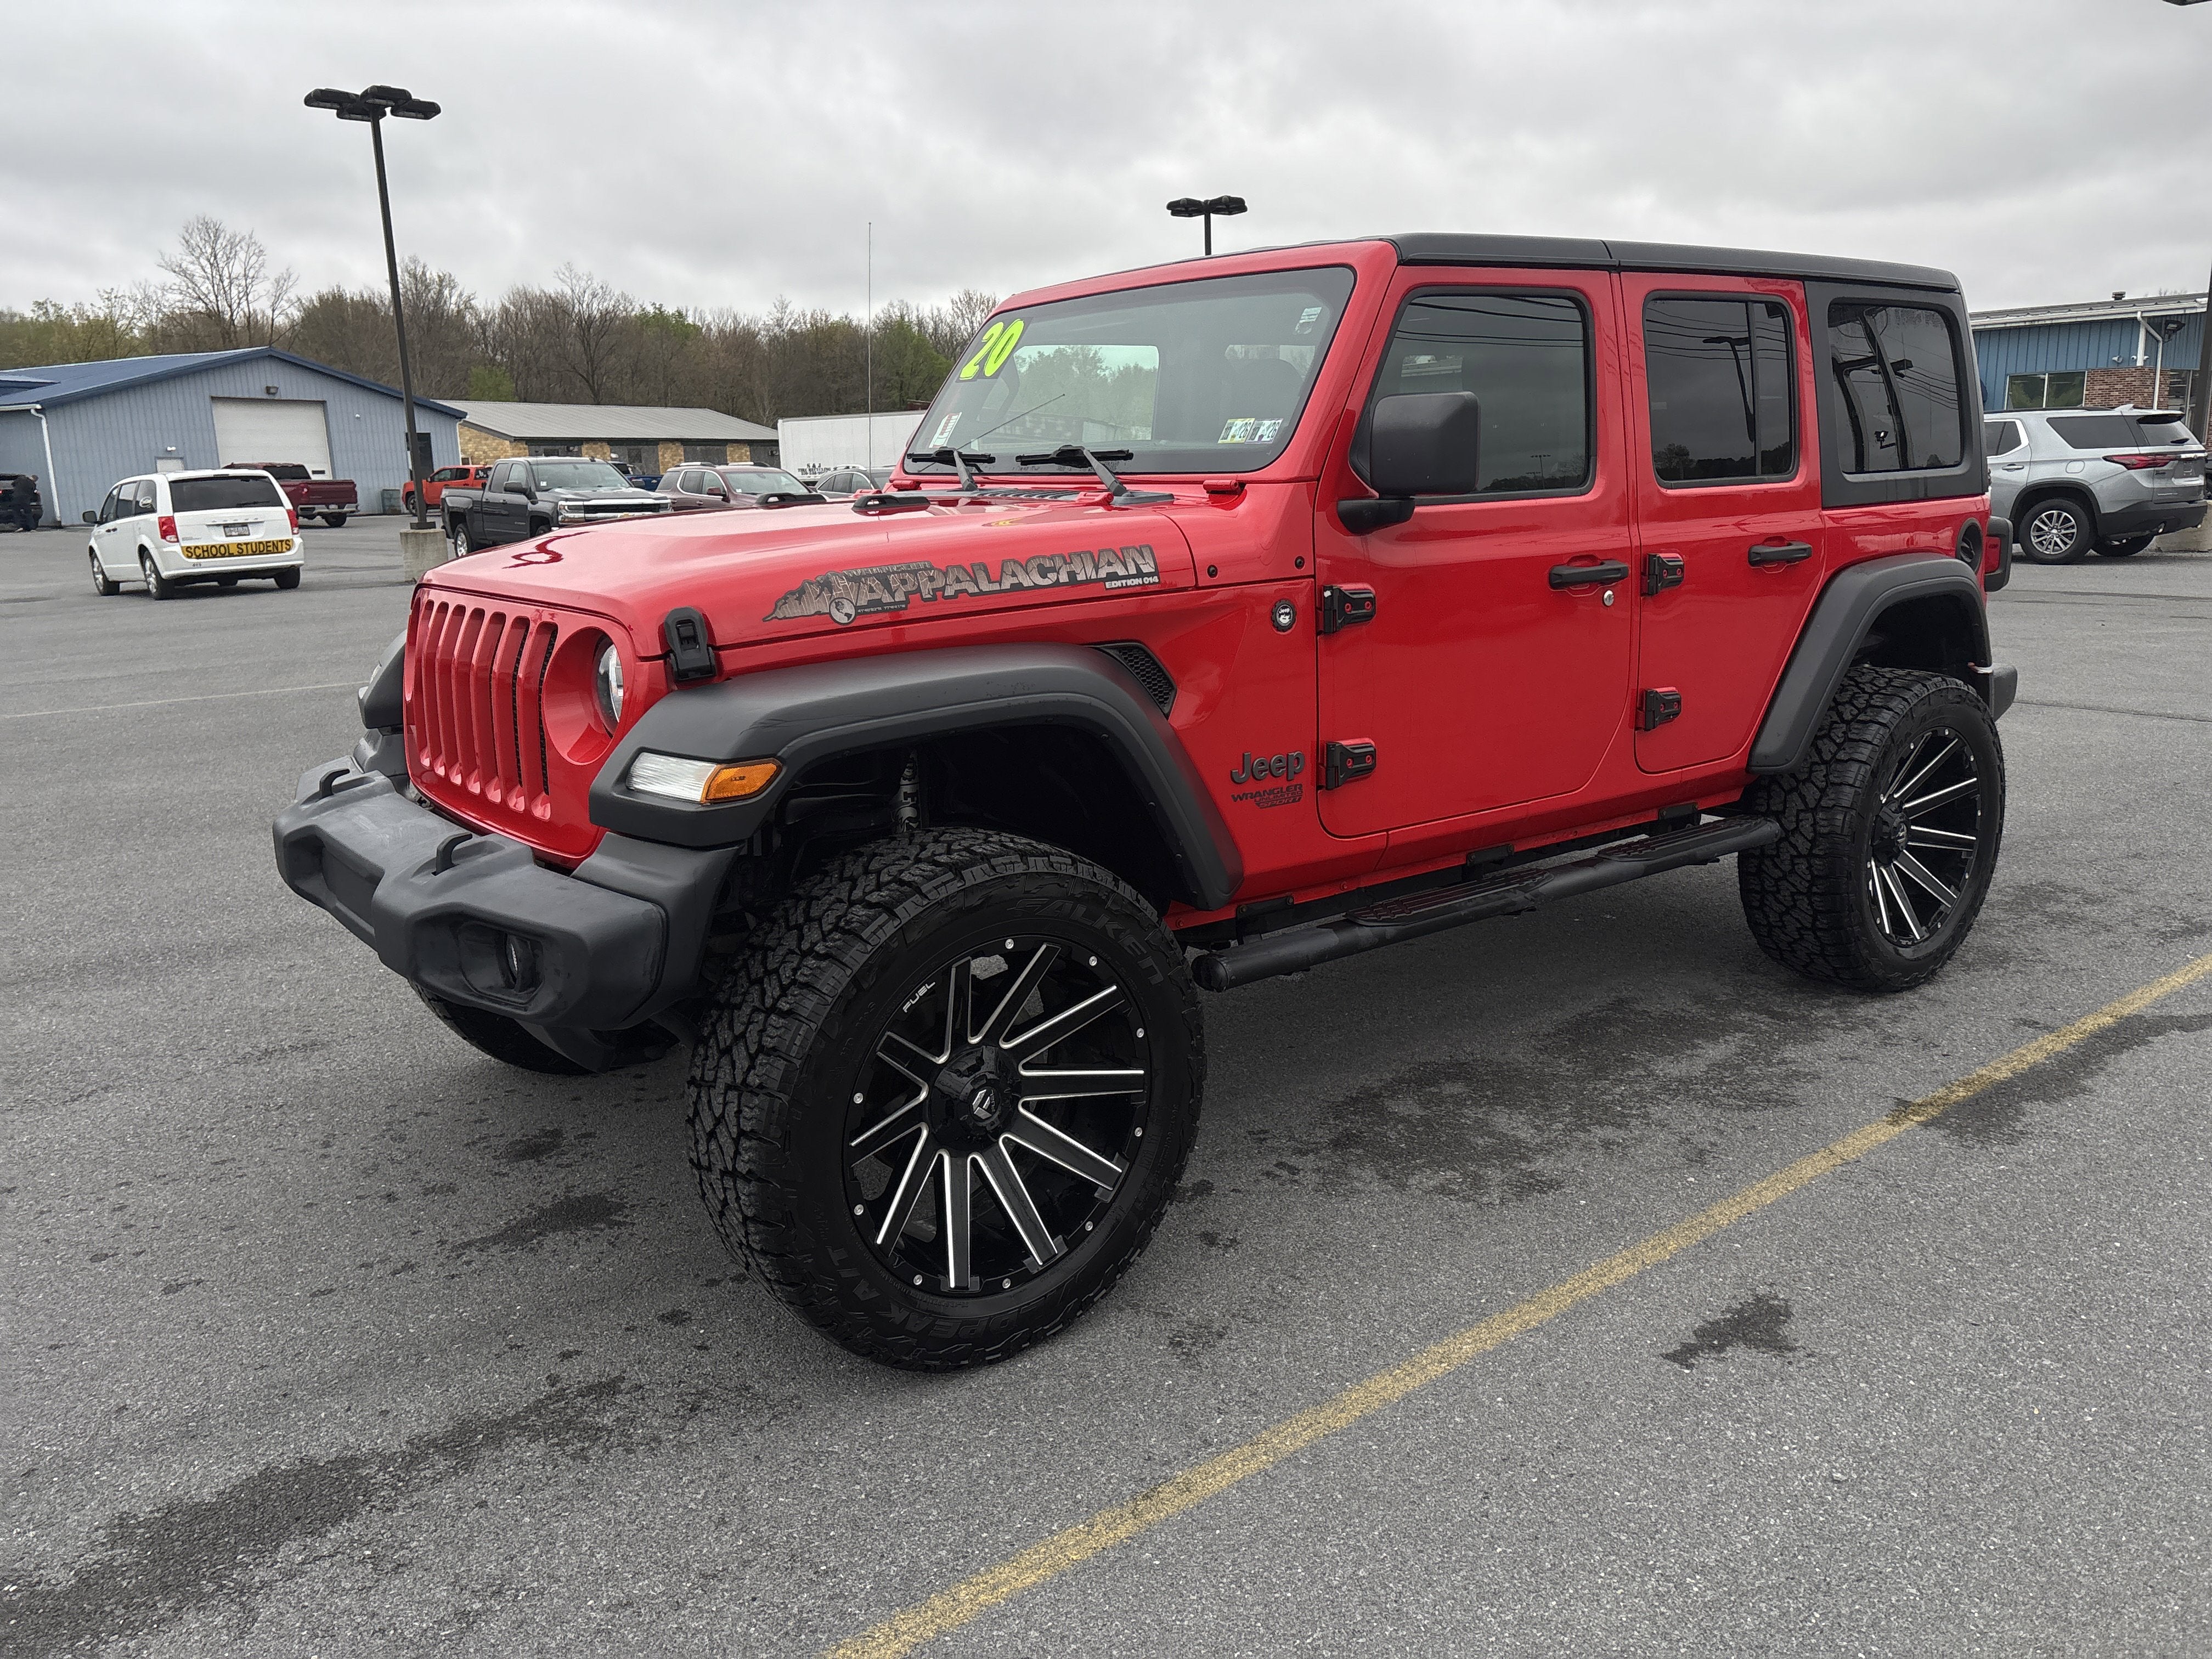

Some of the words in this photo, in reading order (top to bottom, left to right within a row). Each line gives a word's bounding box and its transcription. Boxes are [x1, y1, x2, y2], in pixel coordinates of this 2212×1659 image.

[958, 318, 1025, 380] 20
[1266, 421, 1280, 439] 26
[185, 543, 234, 558] SCHOOL
[236, 539, 291, 555] STUDENTS
[853, 544, 1156, 607] APPALACHIAN
[1105, 578, 1142, 589] EDITION
[1143, 576, 1159, 586] 014
[1231, 751, 1305, 785] Jeep
[1231, 783, 1303, 803] WRANGLER
[1254, 790, 1303, 803] UNLIMITED
[1012, 898, 1164, 986] FALKEN
[902, 981, 936, 1013] FUEL
